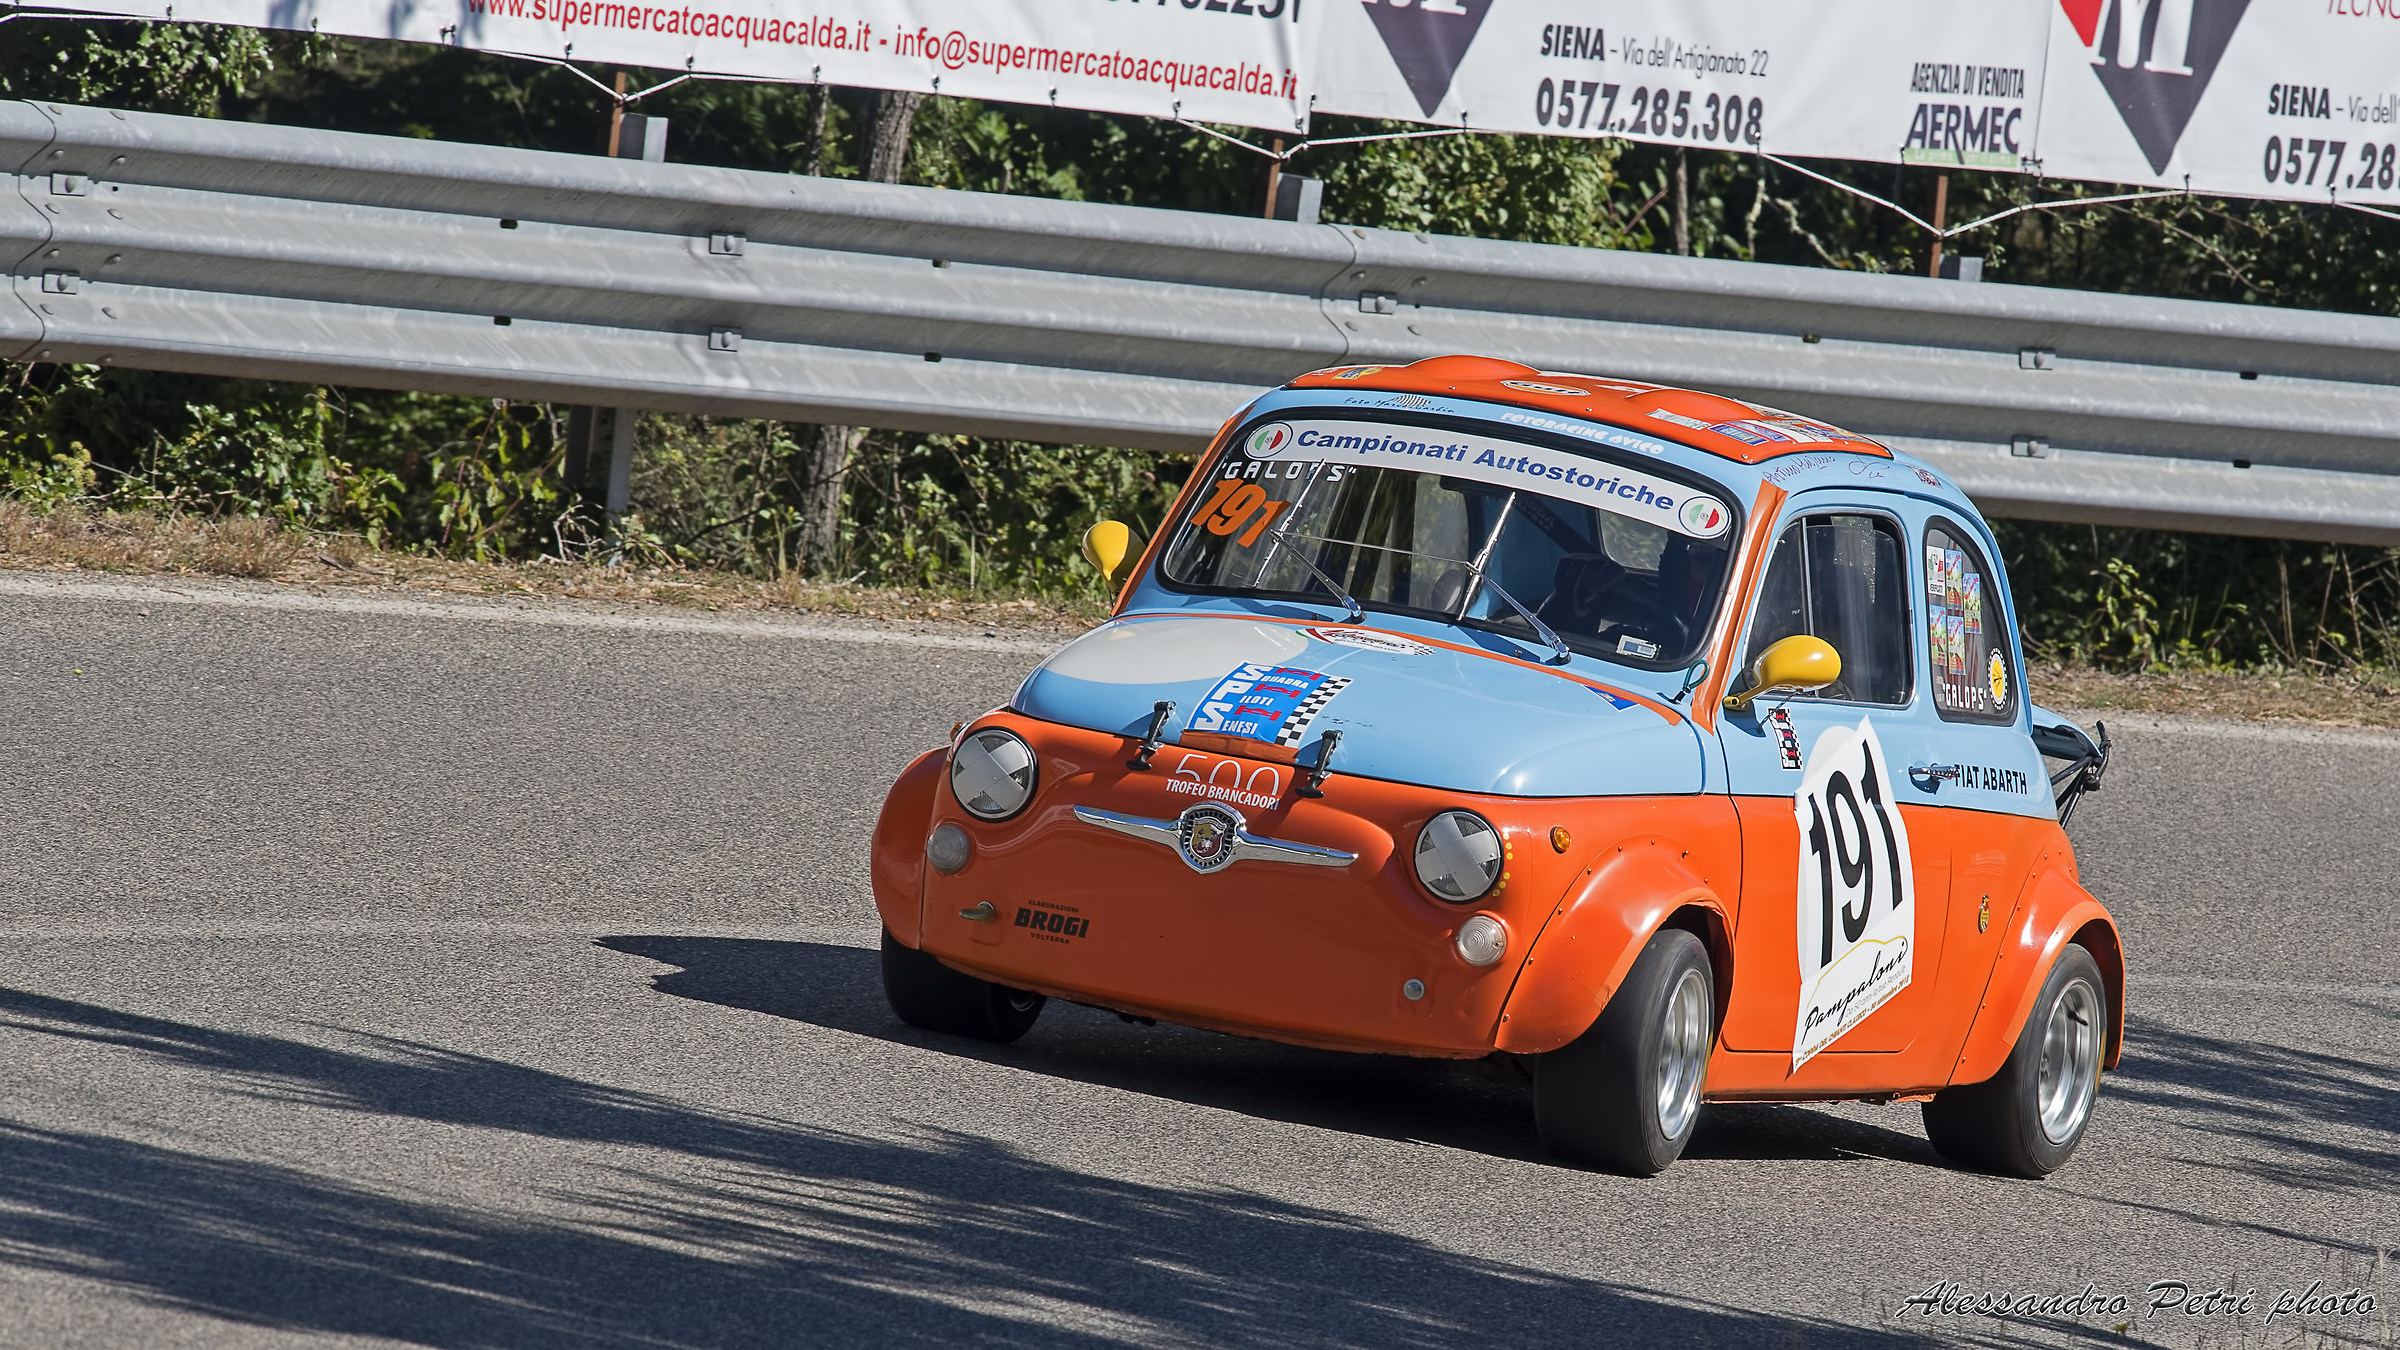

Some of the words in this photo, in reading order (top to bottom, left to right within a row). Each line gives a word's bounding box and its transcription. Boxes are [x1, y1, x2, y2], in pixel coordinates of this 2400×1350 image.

[895, 25, 1298, 100] info@supermercatoacquacalda.it
[1541, 24, 1606, 61] SIENA
[1622, 36, 1643, 65] Via
[1647, 36, 1747, 79] dell'Artigianato
[1750, 49, 1769, 77] 22
[1910, 62, 1960, 94] AGENZIA
[1963, 65, 1977, 95] DI
[1978, 66, 2024, 99] VENDITA
[2268, 83, 2331, 120] SIENA
[2349, 95, 2368, 123] Via
[1536, 76, 1763, 146] 0577.285.308
[1905, 103, 2022, 164] AERMEC
[2264, 135, 2400, 191] 0577.28
[1500, 412, 1609, 439] FOTORACING
[1608, 434, 1665, 455] AVICO
[1297, 430, 1469, 462] Campionati
[1472, 448, 1675, 510] Autostoriche
[1190, 478, 1293, 549] 191
[1165, 778, 1207, 797] TROFEO
[1206, 785, 1280, 811] BRANCADORI
[1175, 753, 1280, 796] 500
[1953, 763, 1980, 789] FIAT
[1982, 766, 2028, 796] ABARTH
[1808, 738, 1903, 969] 191
[1014, 906, 1090, 938] BROGI
[1028, 899, 1079, 913] ELABORAZIONI
[1030, 932, 1070, 944] VOLTERRA
[1801, 941, 1907, 1046] Pampaloni
